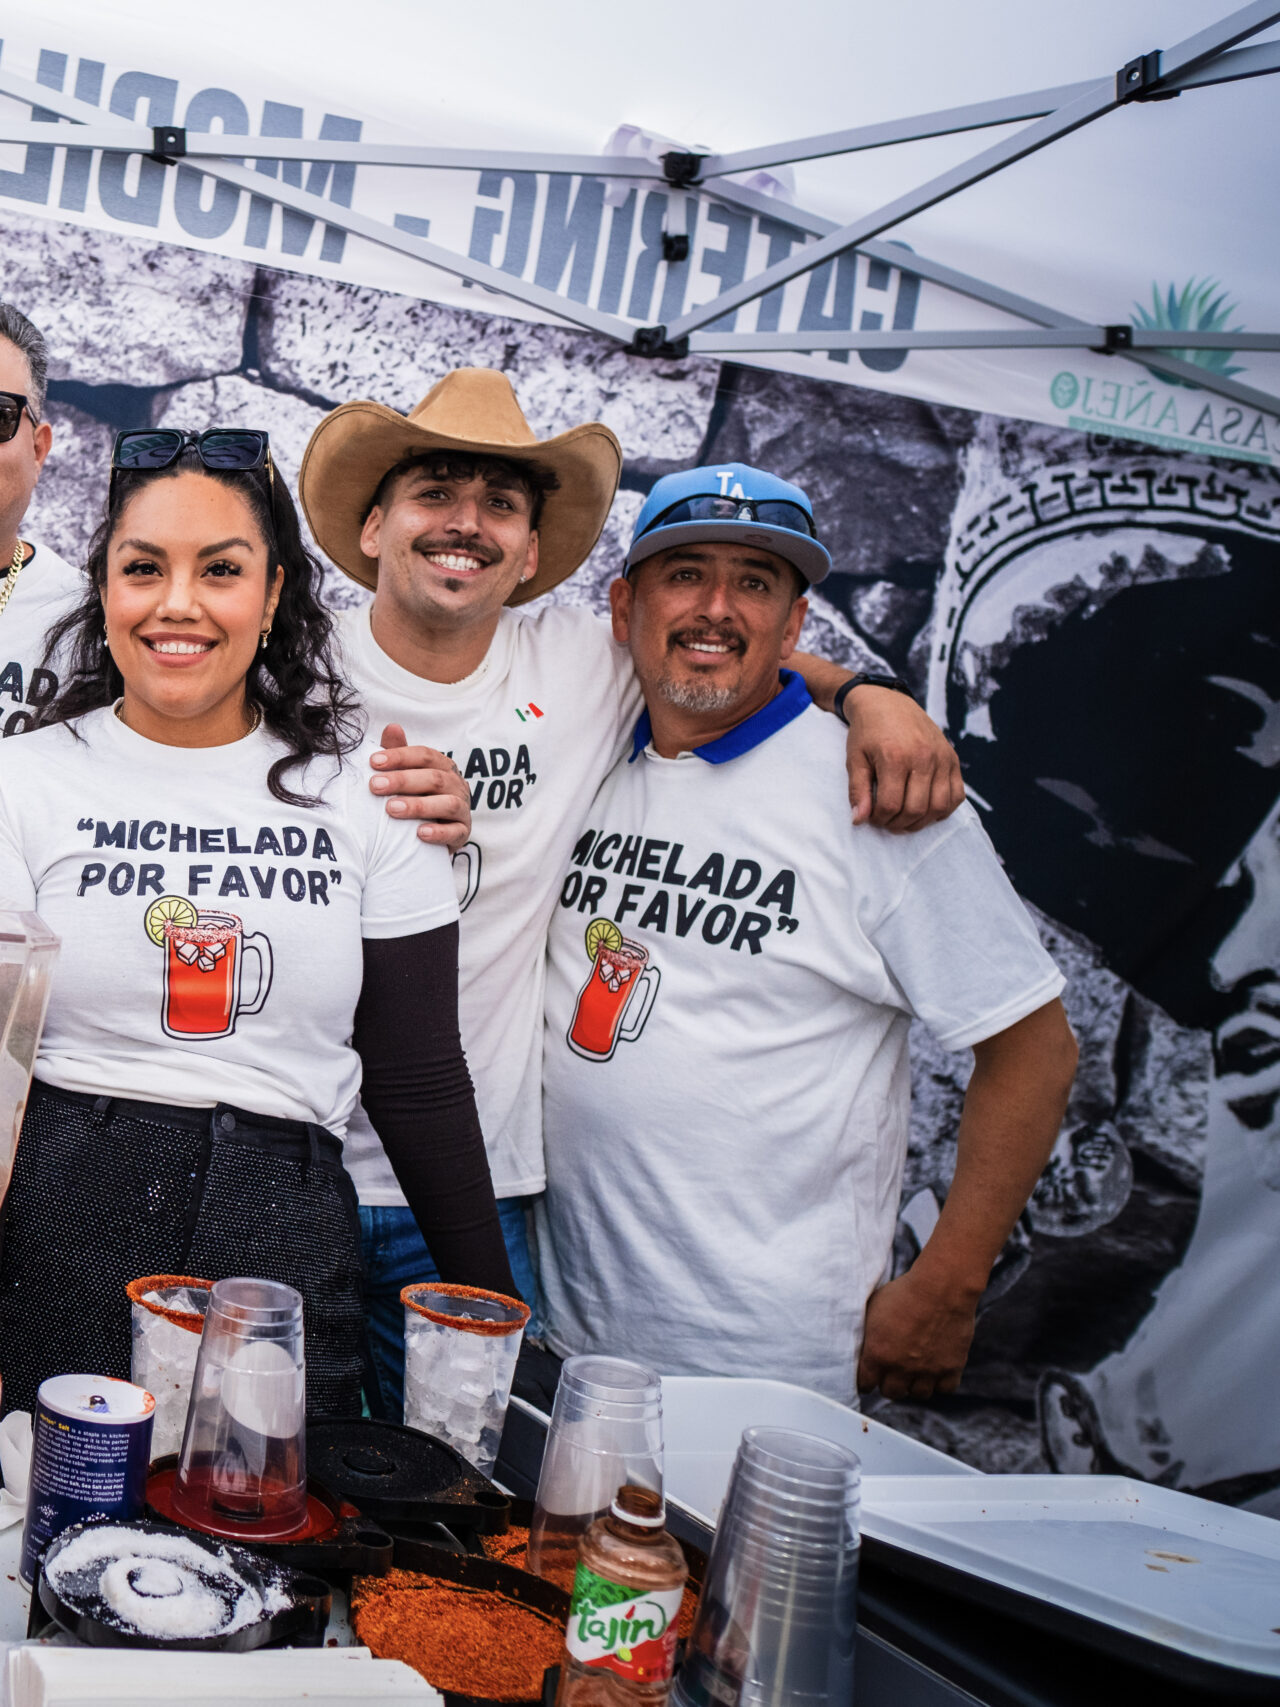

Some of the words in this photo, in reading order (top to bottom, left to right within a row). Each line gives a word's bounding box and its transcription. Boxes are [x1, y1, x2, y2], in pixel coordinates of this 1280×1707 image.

[76, 817, 338, 862] “MICHELADA
[76, 861, 166, 897] POR
[188, 864, 342, 906] FAVOR”
[560, 870, 608, 916] OR
[613, 883, 800, 956] FAVOR”
